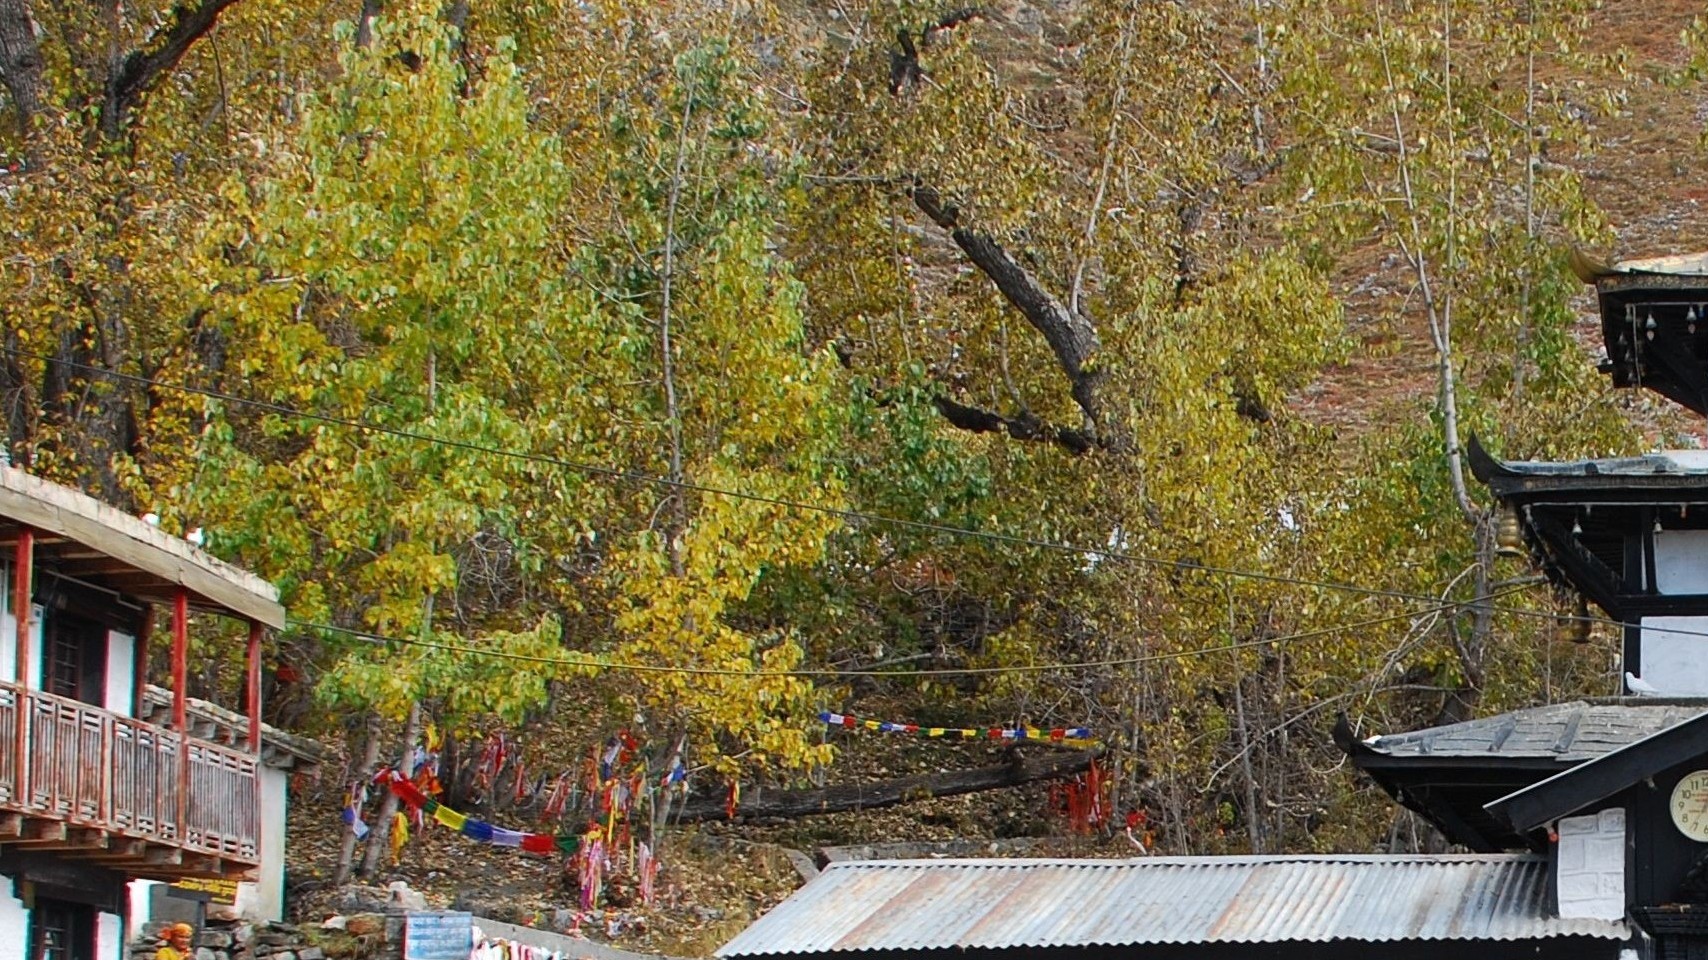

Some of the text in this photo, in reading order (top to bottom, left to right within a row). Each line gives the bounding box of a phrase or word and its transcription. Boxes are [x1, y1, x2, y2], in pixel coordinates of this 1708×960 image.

[1691, 780, 1699, 790] 11
[1682, 789, 1692, 799] 10
[1678, 801, 1685, 810] 9
[1682, 813, 1688, 823] 8
[1693, 821, 1699, 832] 7
